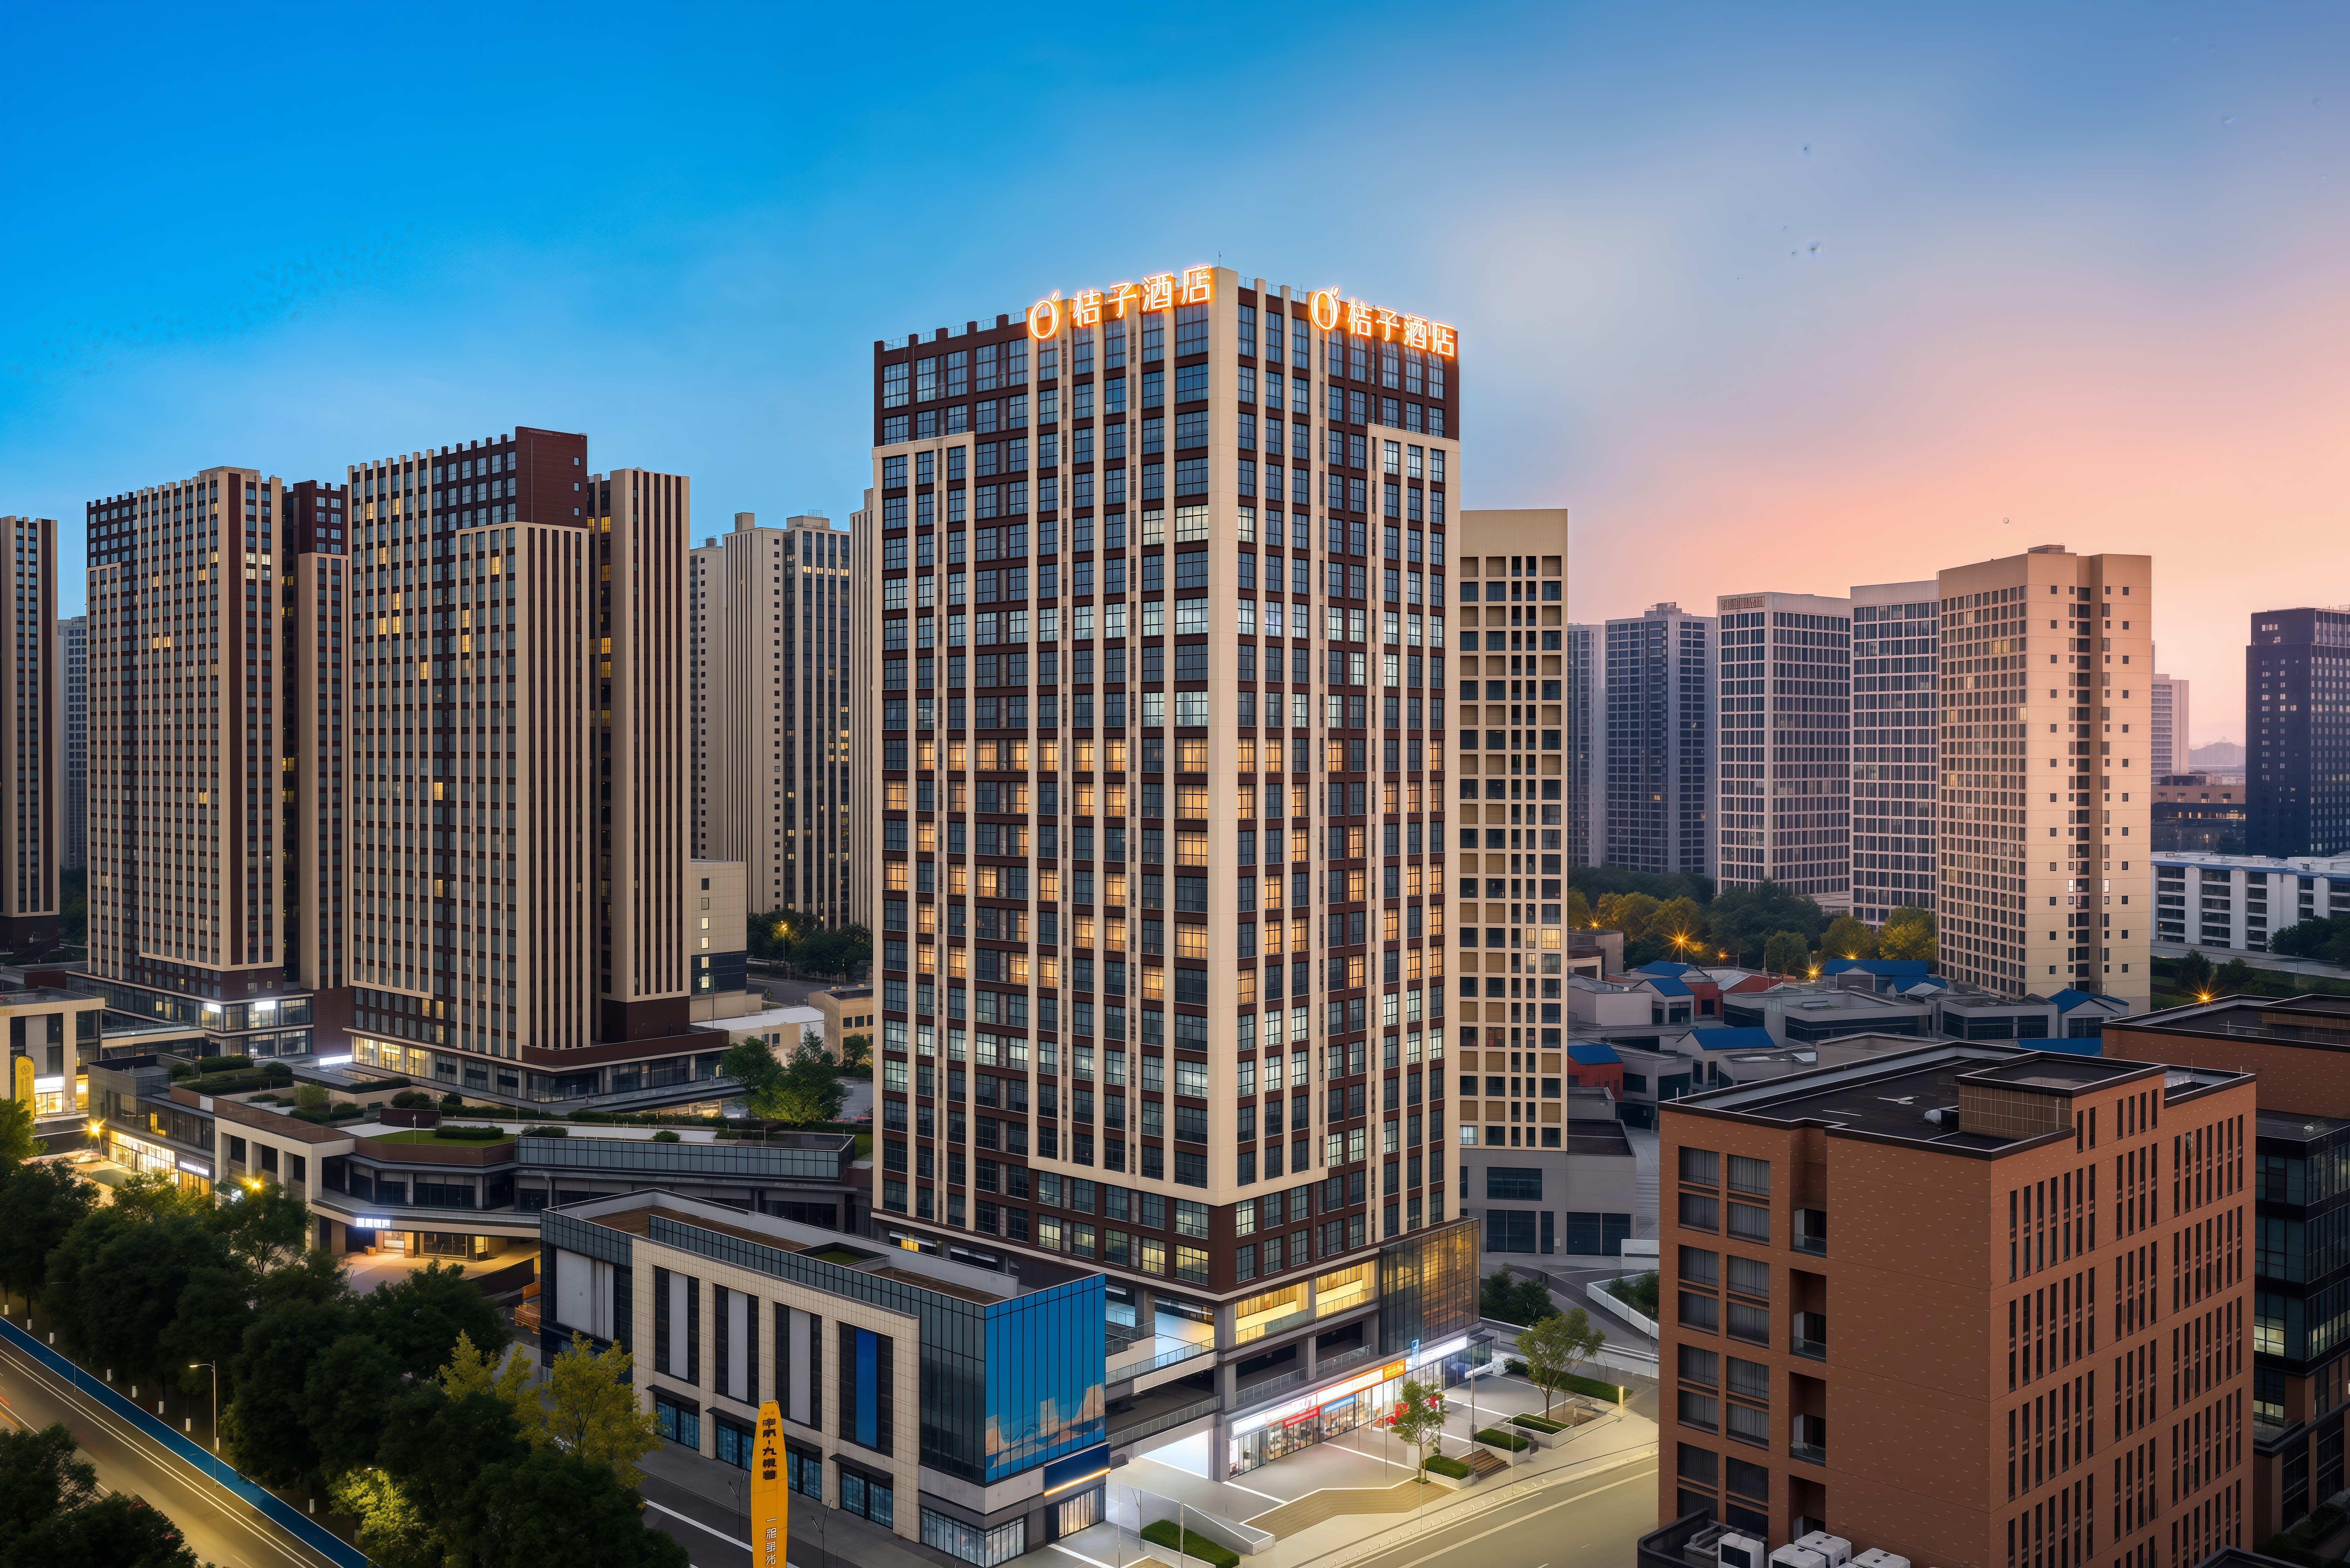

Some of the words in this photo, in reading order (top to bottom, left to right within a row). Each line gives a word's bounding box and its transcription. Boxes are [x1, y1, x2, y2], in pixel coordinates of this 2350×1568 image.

[1072, 265, 1211, 328] 桔子酒店
[1347, 297, 1455, 357] 桔子酒店
